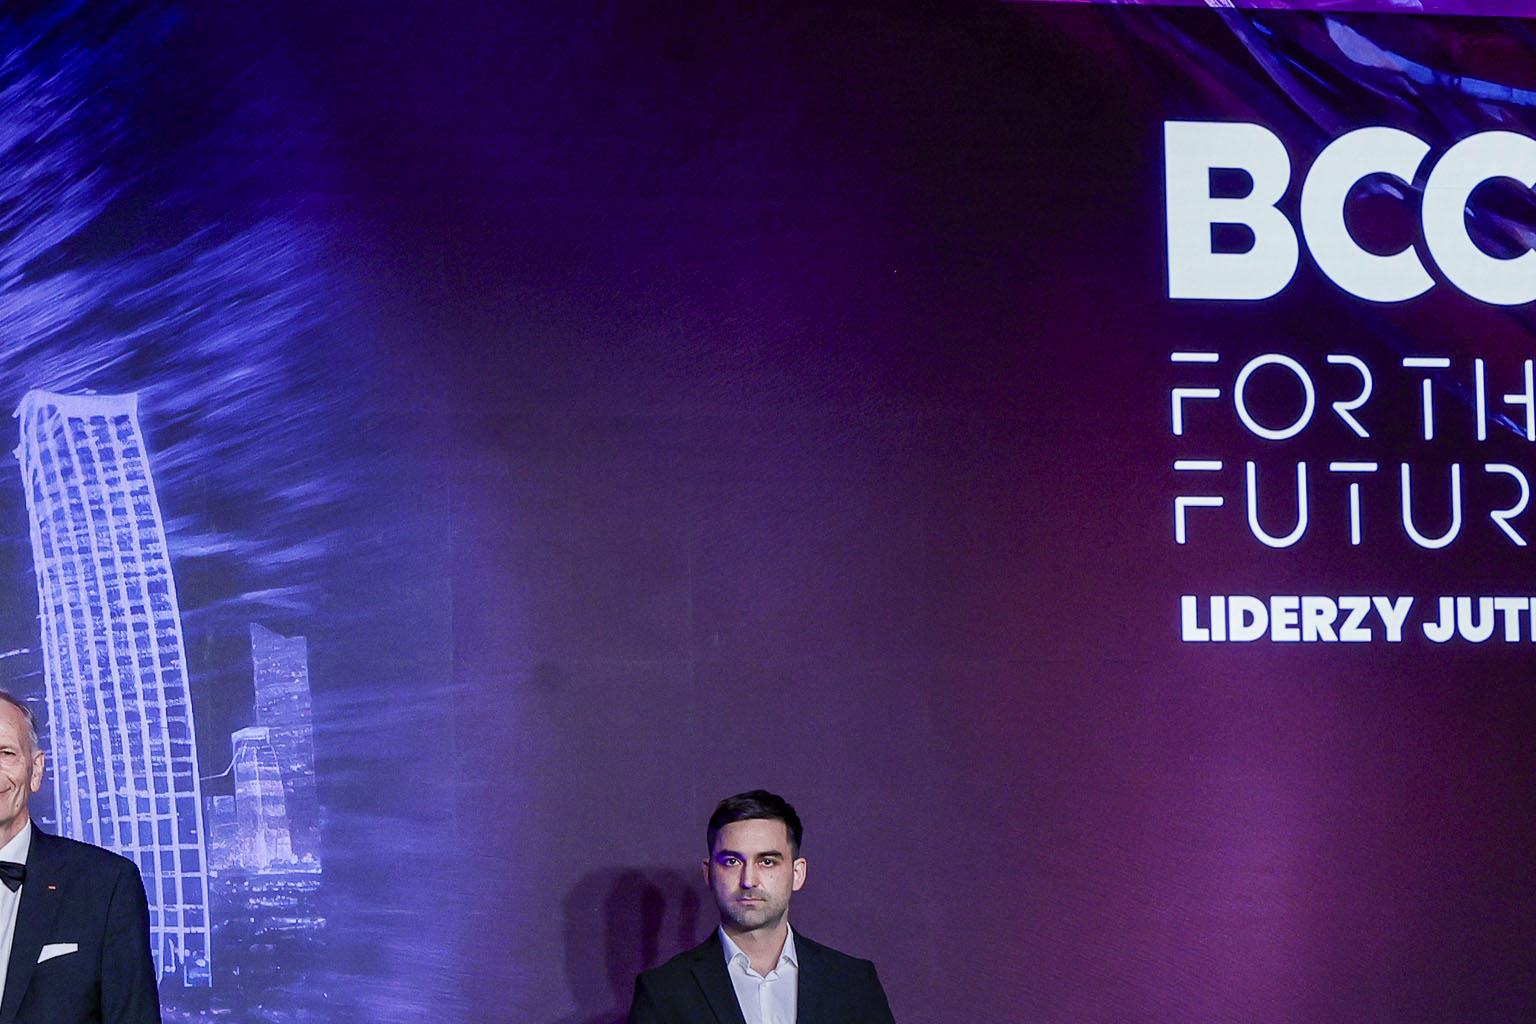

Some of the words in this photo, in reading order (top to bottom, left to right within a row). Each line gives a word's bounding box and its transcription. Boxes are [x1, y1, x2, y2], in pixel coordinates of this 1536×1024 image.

[1164, 121, 1536, 306] BCC
[1170, 352, 1373, 441] FOR
[1174, 460, 1530, 549] FUTUR
[1181, 596, 1414, 643] LIDERZY
[1422, 597, 1536, 643] JUT
